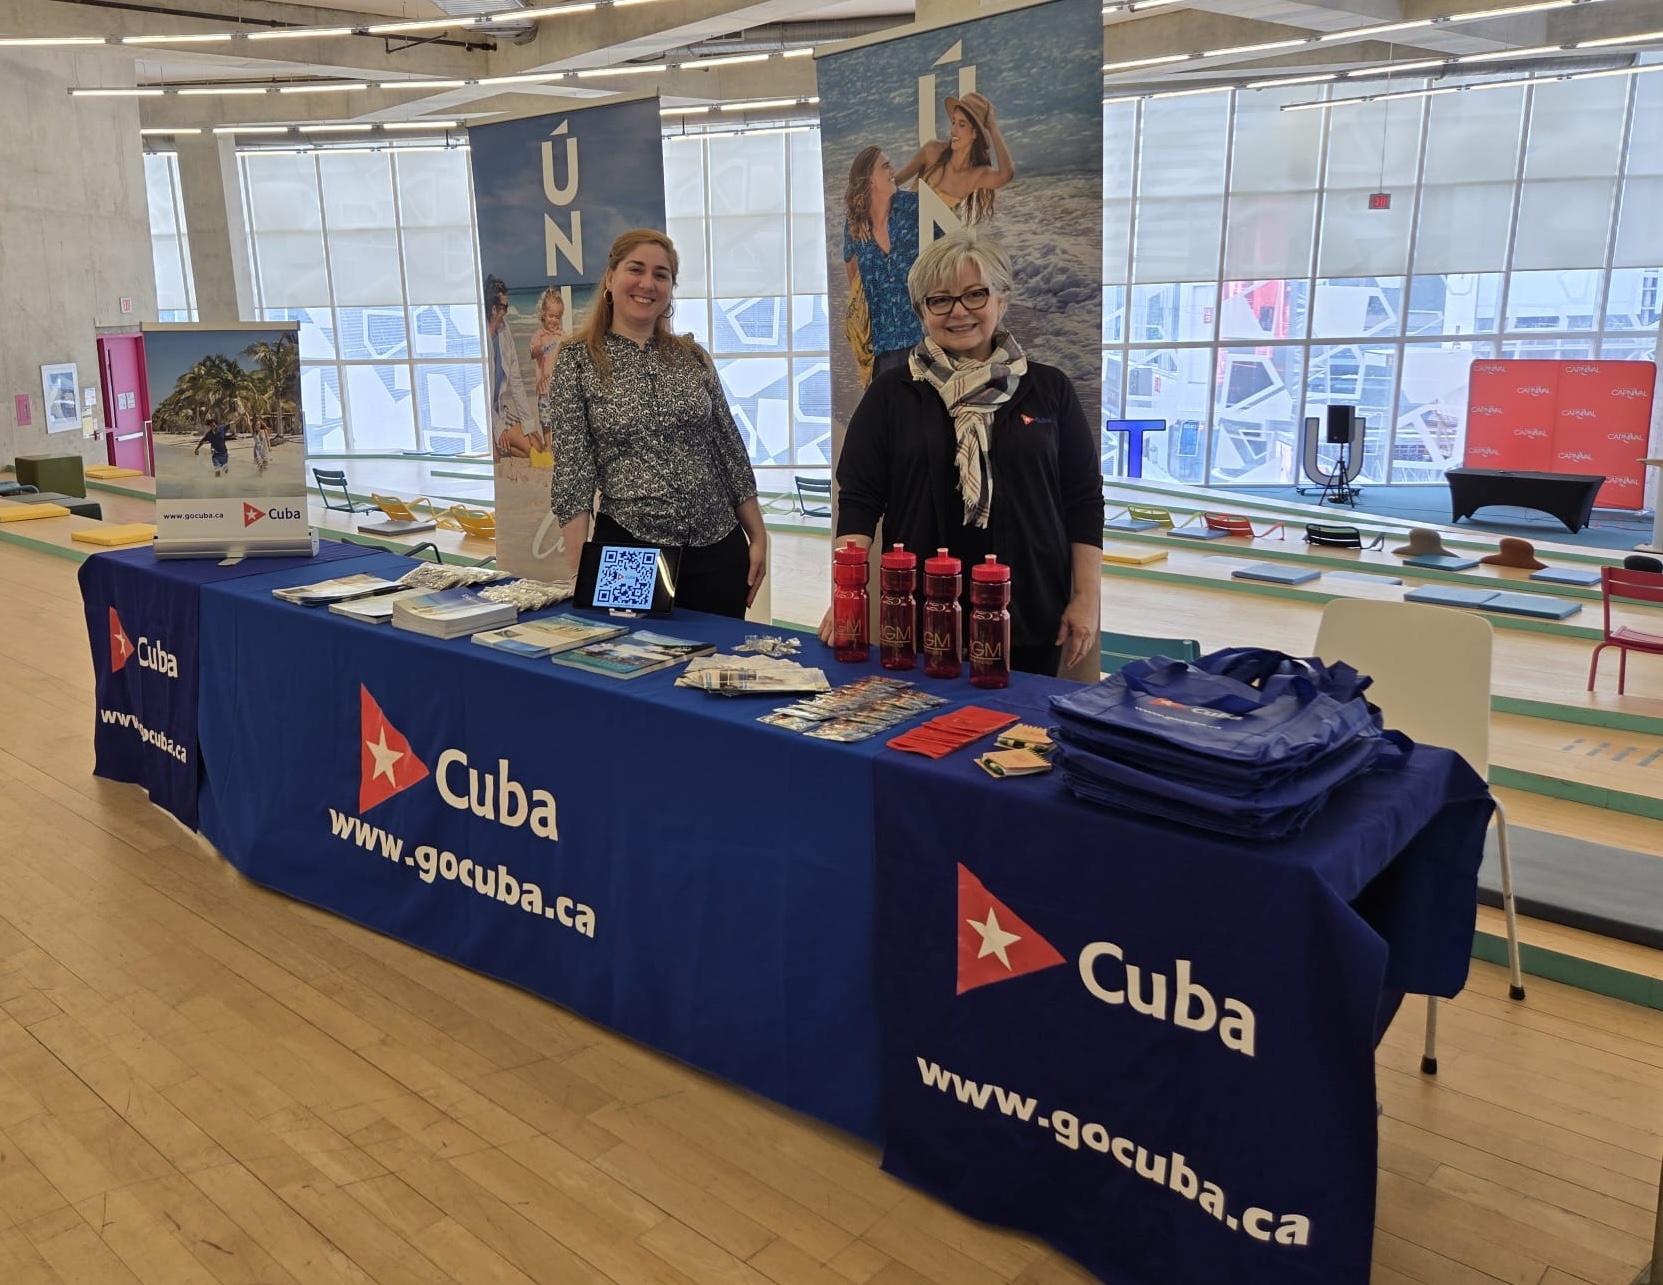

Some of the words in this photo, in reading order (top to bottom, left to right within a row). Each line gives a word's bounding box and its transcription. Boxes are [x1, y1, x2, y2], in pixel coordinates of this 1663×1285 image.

[1106, 419, 1167, 478] T
[163, 512, 224, 520] www.gocuba.ca
[268, 508, 301, 520] Cuba
[137, 636, 179, 678] Cuba
[435, 748, 559, 842] Cuba
[328, 808, 597, 938] www.gocuba.ca
[1078, 941, 1257, 1057] Cuba
[916, 1056, 1311, 1246] www.gocuba.ca
